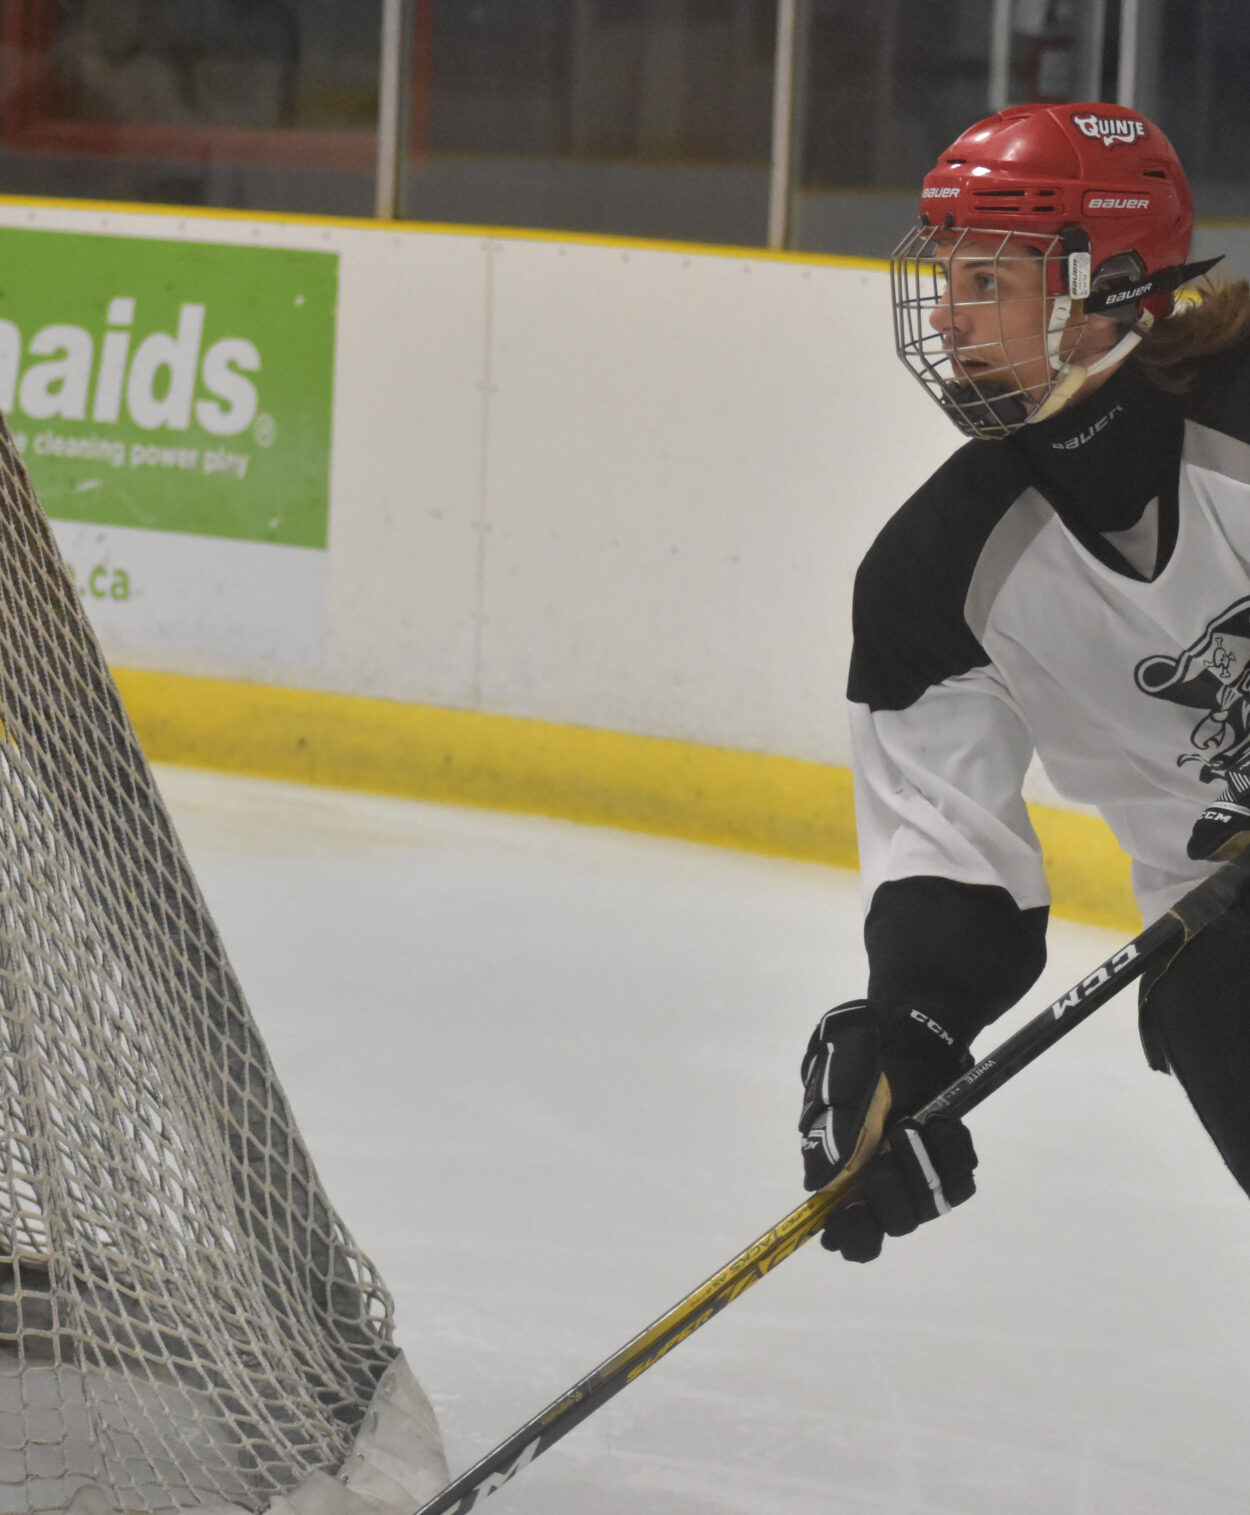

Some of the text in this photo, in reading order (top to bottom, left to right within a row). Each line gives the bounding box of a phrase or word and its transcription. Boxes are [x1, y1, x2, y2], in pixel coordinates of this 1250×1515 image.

[1073, 114, 1146, 147] QUINTE
[921, 186, 961, 199] BAUER
[1087, 198, 1150, 209] BAUER
[1105, 282, 1153, 305] BAUER
[129, 443, 199, 469] power
[1051, 943, 1142, 1021] CCM
[909, 1008, 955, 1046] CCM
[966, 1059, 997, 1085] WHITE
